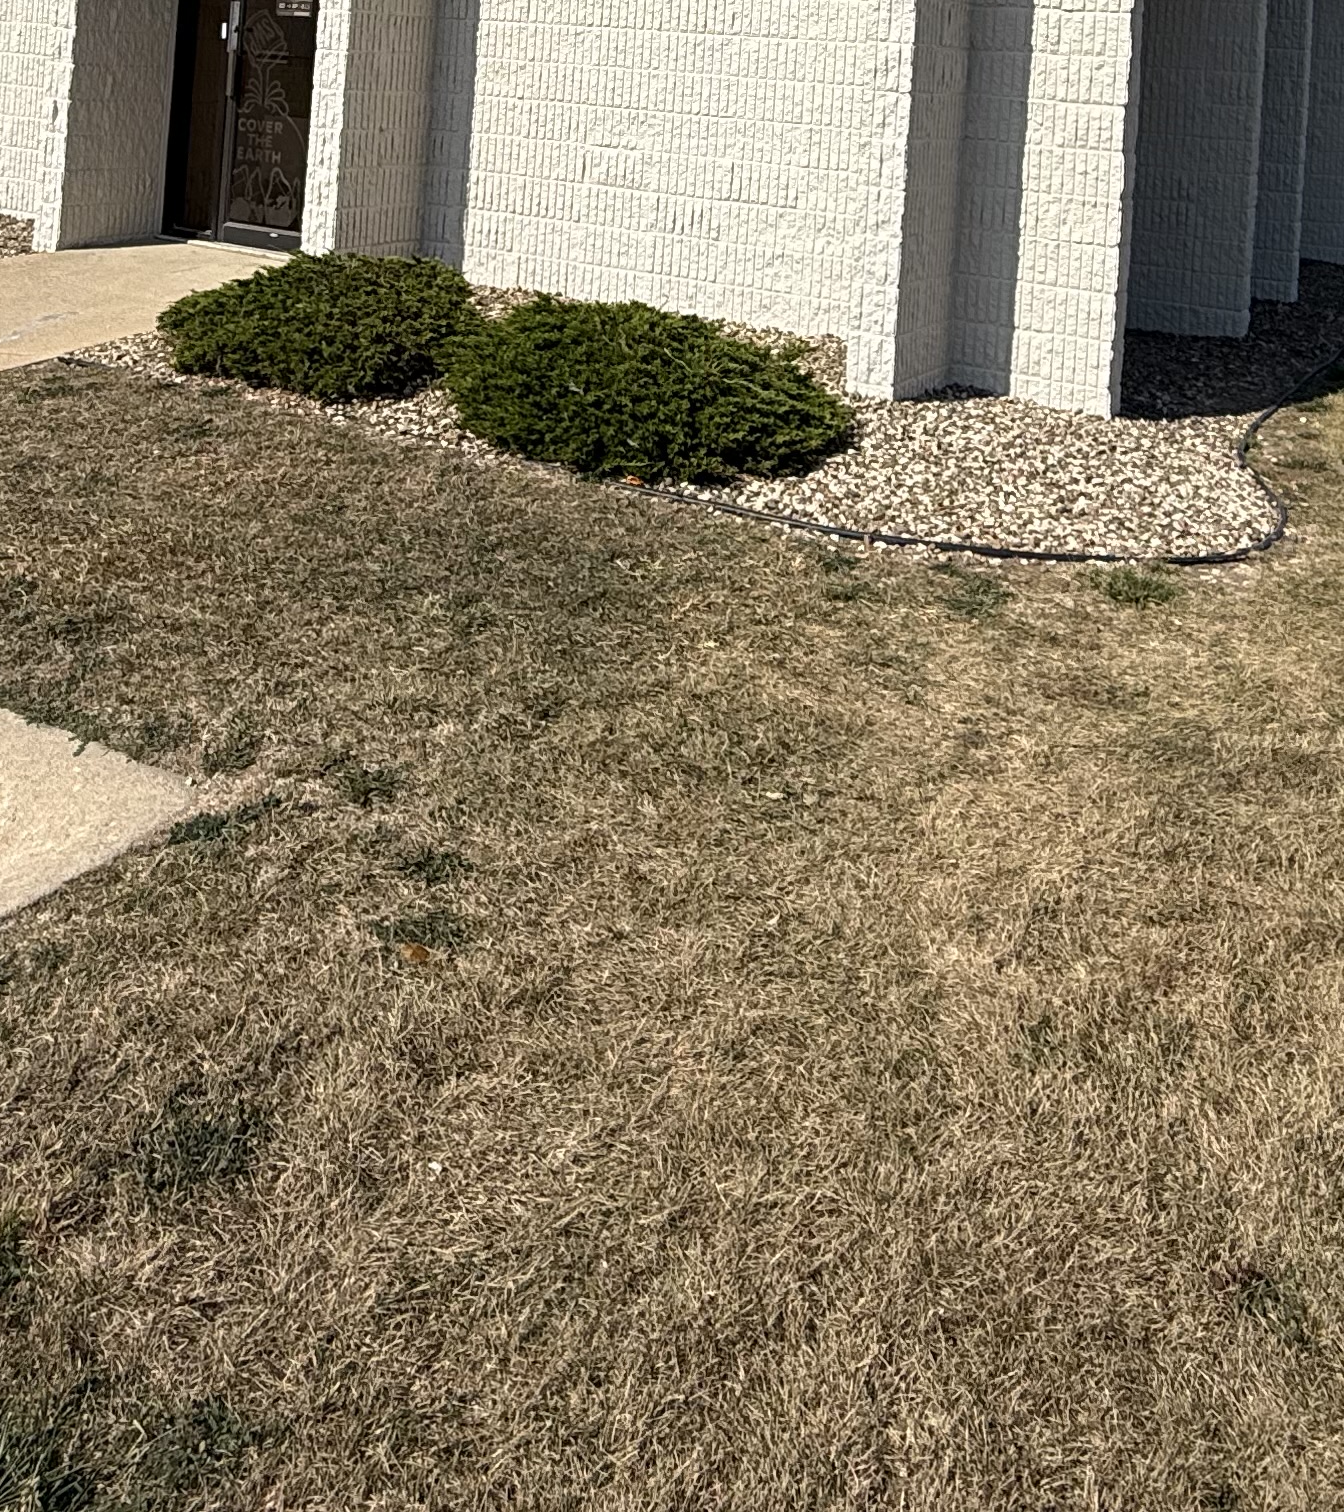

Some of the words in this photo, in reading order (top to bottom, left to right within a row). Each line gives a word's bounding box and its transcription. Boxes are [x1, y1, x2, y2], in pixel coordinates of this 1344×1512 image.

[238, 118, 284, 134] COVER
[247, 133, 273, 148] THE
[236, 146, 282, 164] EARTH
